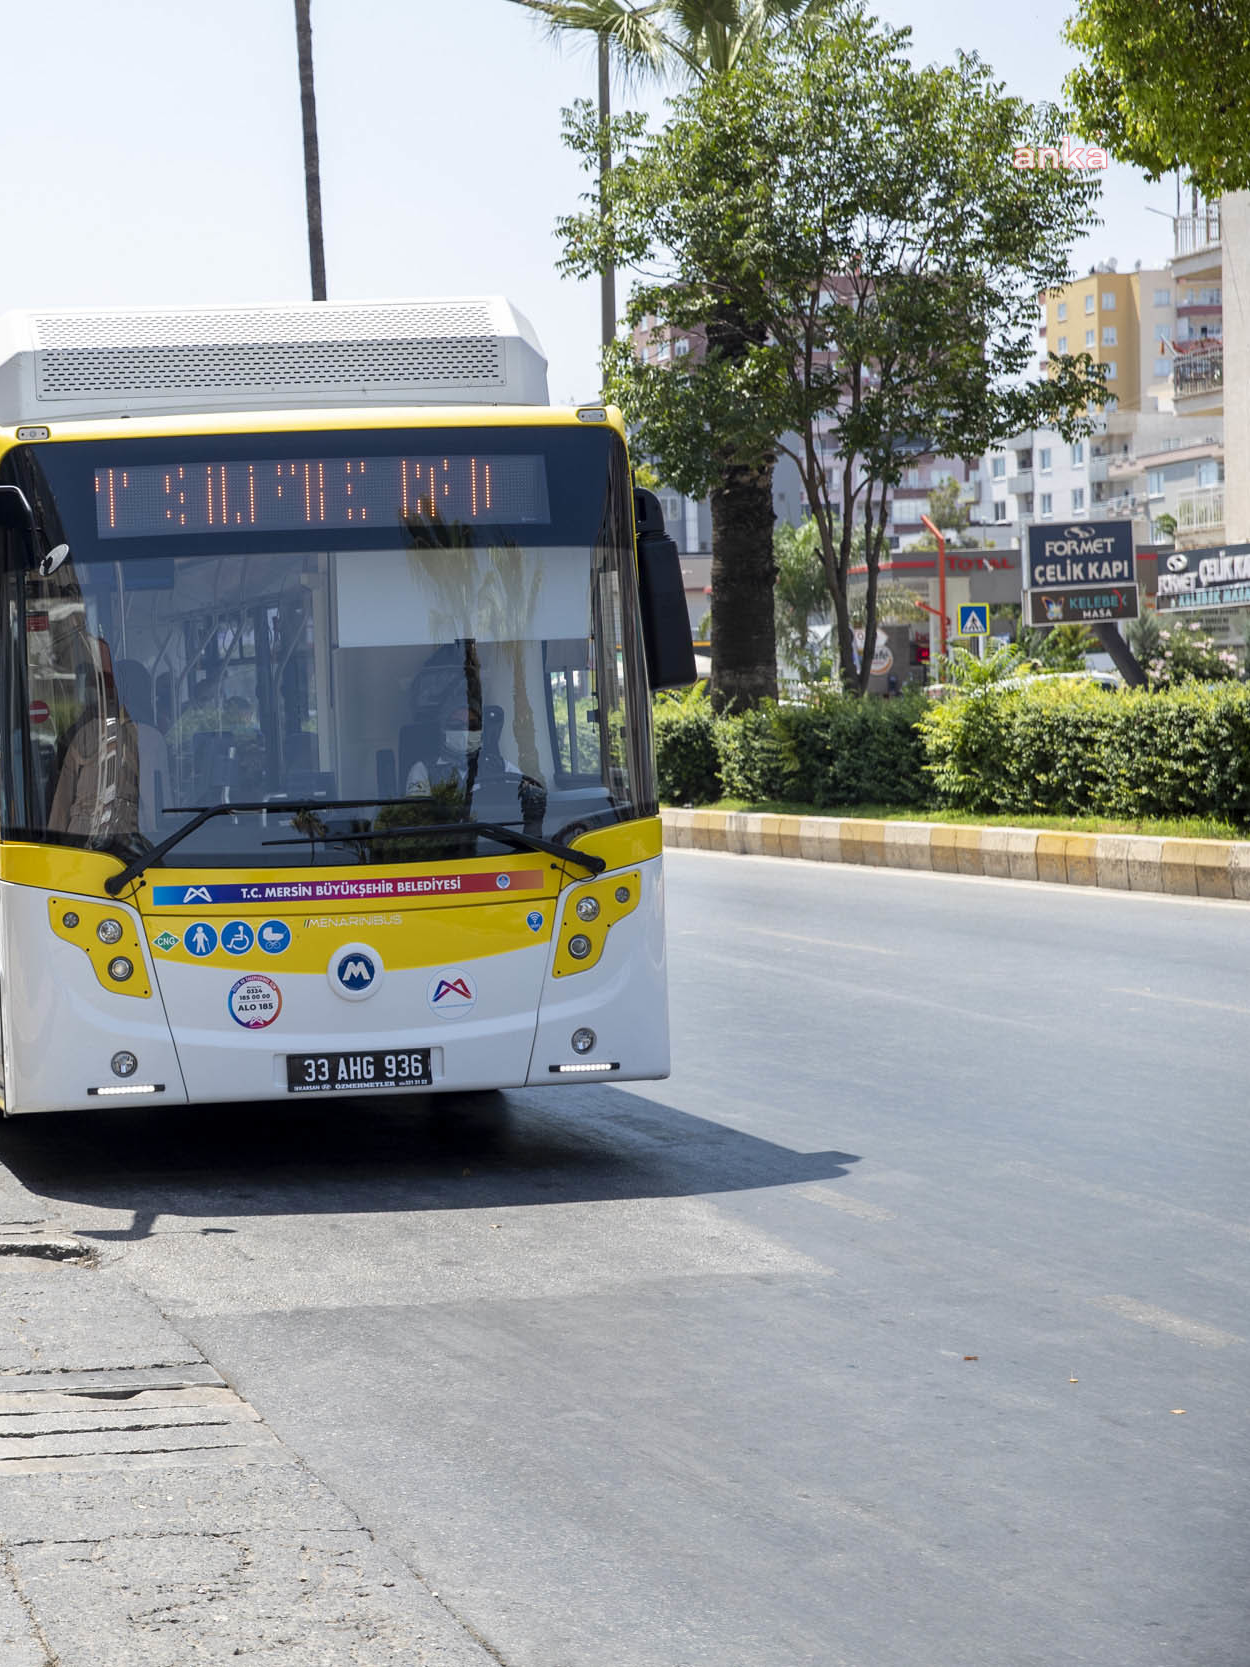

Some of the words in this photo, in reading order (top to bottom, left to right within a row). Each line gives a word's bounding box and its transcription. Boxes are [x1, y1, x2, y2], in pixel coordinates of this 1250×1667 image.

[1044, 537, 1115, 557] FORMET
[946, 555, 1015, 571] TOTAL
[1034, 559, 1085, 585] ÇELİK
[1088, 559, 1130, 580] KAPI
[1083, 608, 1112, 619] MASA
[241, 888, 262, 899] T.C.
[265, 883, 312, 898] MERSİN
[316, 879, 394, 897] BÜYÜKŞEHİR
[397, 876, 461, 893] BELEDİYESİ
[157, 937, 176, 946] CNG
[342, 961, 371, 981] M
[238, 1004, 257, 1012] ALO
[259, 1002, 273, 1010] 185
[304, 1058, 329, 1082] 33
[337, 1056, 375, 1081] AHG
[384, 1054, 422, 1078] 936
